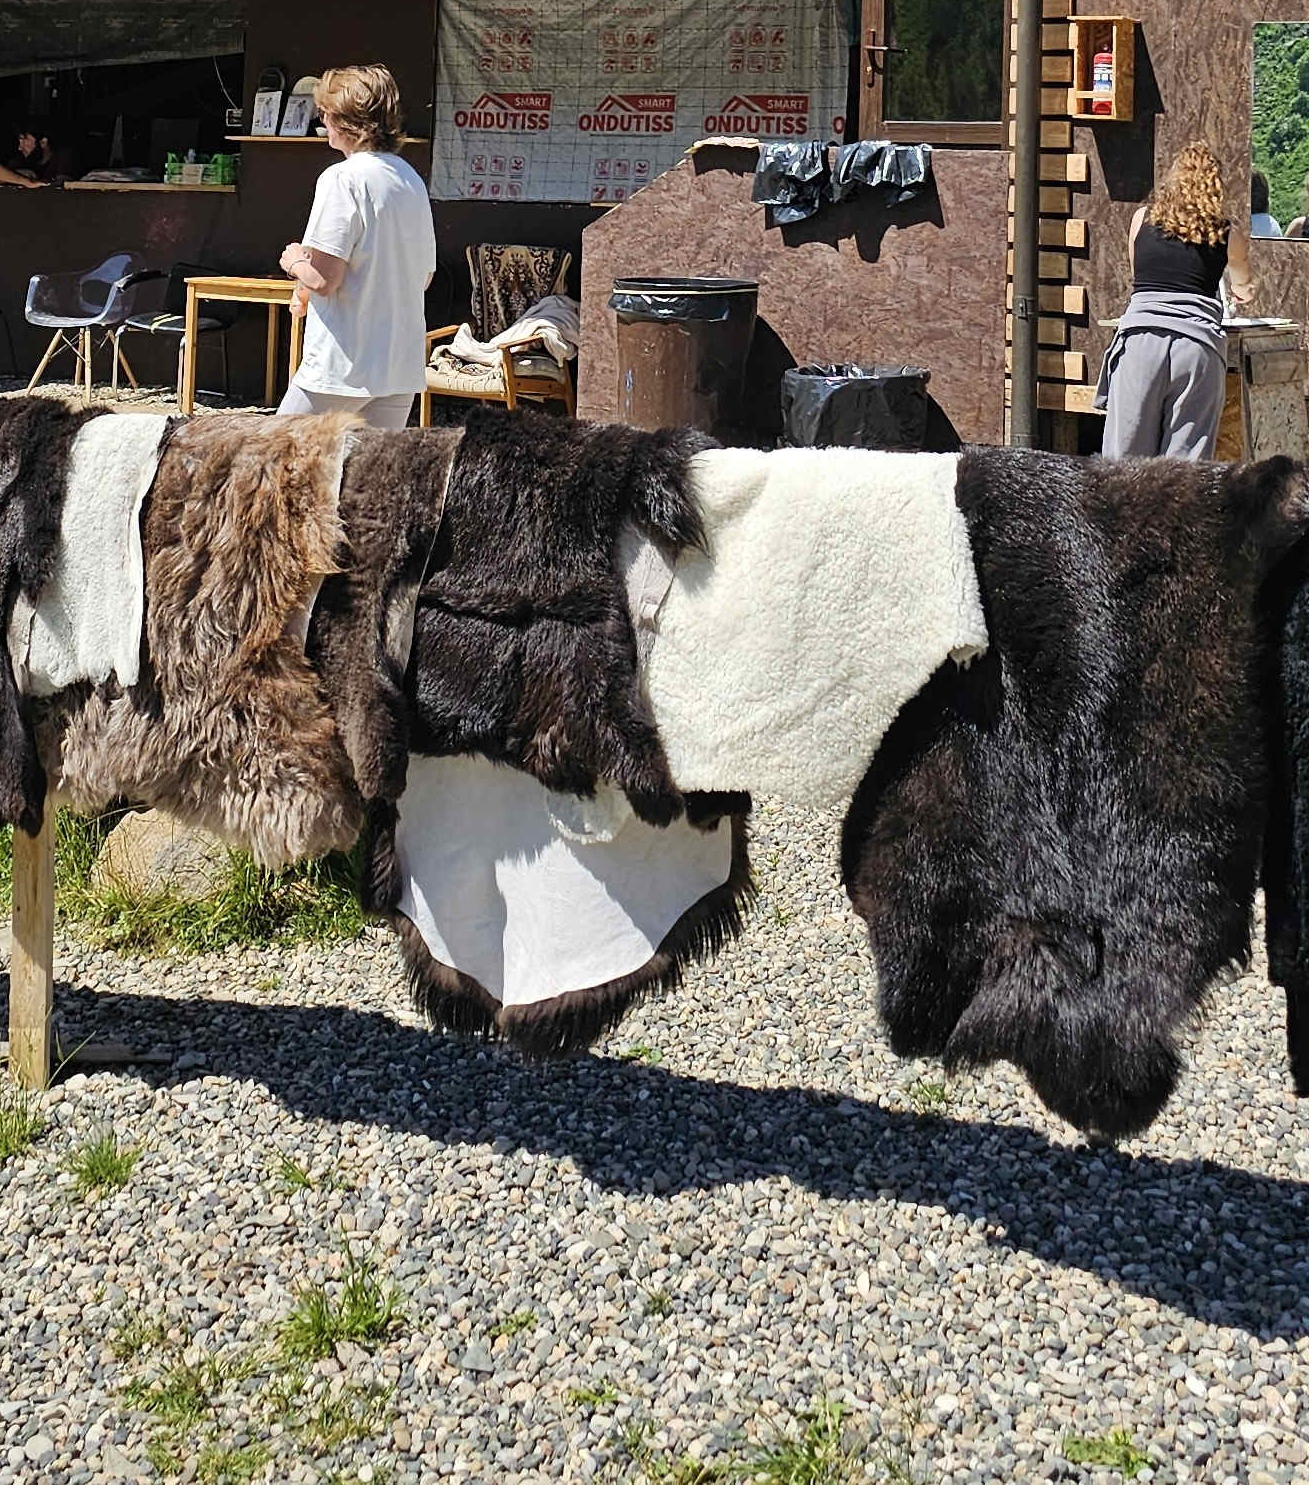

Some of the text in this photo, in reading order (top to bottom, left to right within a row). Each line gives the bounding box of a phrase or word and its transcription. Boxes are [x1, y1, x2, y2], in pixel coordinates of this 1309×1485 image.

[515, 97, 547, 107] SMART
[638, 98, 671, 108] SMART
[767, 99, 805, 110] SMART
[454, 110, 550, 130] ONDUTISS
[578, 113, 674, 133] ONDUTISS
[704, 115, 808, 134] ONDUTISS
